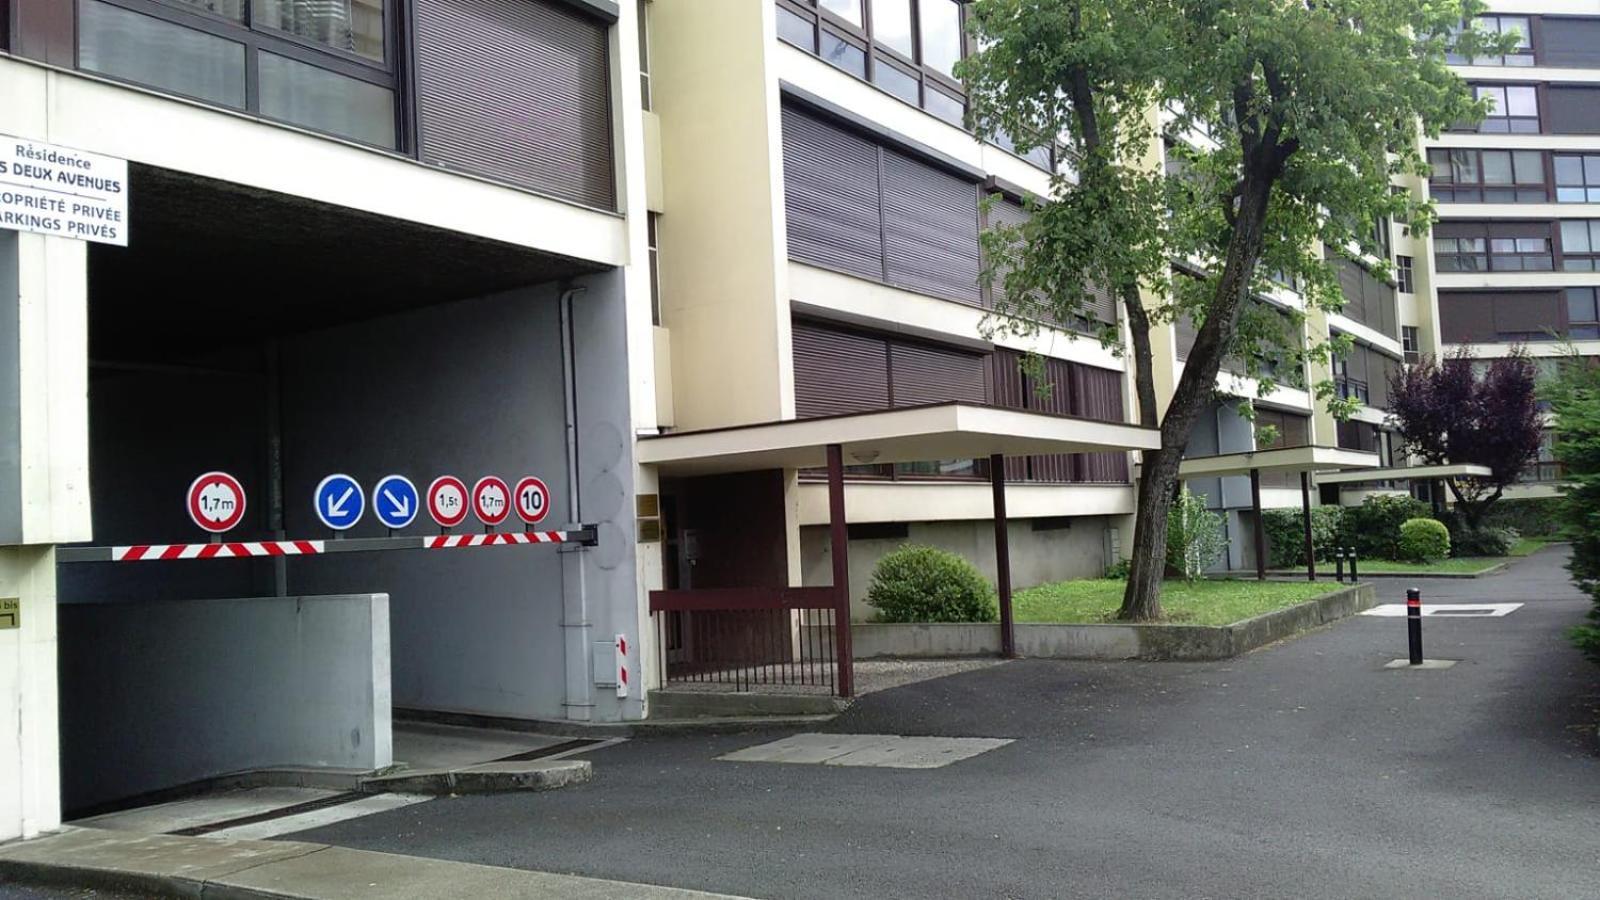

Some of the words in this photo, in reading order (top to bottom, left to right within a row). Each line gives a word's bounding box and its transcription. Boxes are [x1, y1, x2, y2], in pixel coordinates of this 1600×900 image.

[16, 144, 91, 169] Résidence
[13, 162, 52, 182] DEUX
[57, 171, 121, 193] AVENUES
[0, 192, 66, 213] OPRIÉTÉ
[73, 203, 121, 222] PRIVÉE
[0, 211, 61, 231] RKINGS
[68, 221, 117, 239] PRIVÉS
[523, 490, 542, 510] 10
